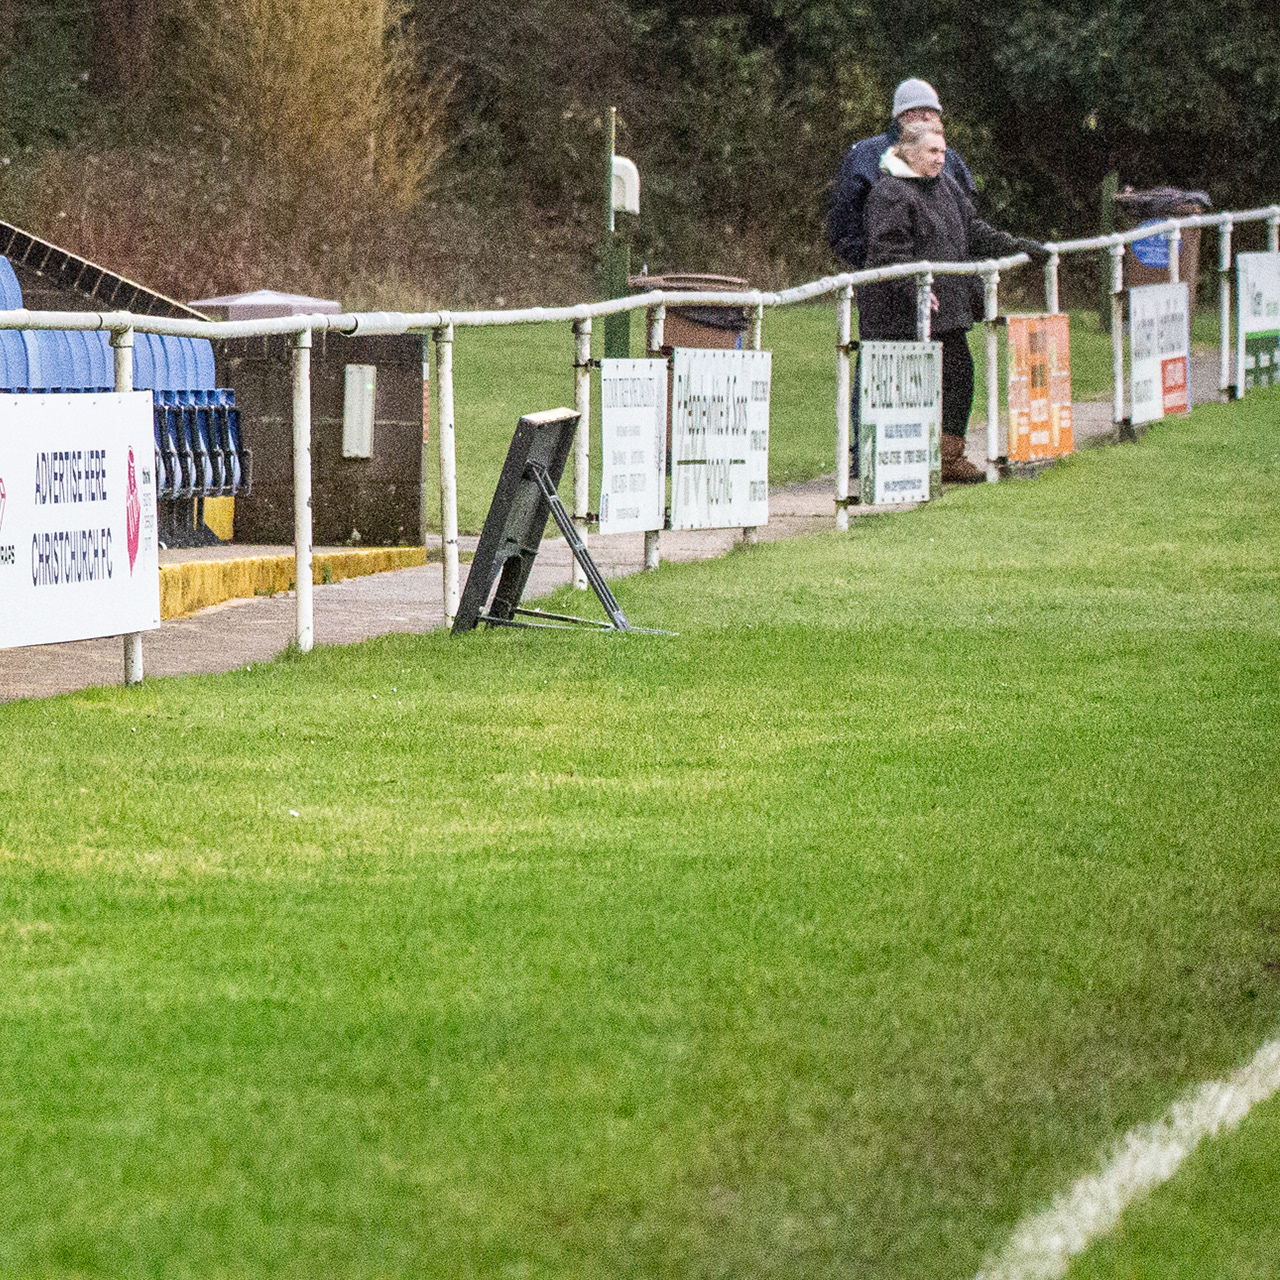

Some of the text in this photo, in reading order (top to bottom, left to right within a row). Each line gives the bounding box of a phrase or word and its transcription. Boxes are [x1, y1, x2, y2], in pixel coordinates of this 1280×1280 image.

[34, 449, 107, 505] ADVERTISE HERE
[31, 526, 113, 587] CHRISTCHURCH FC
